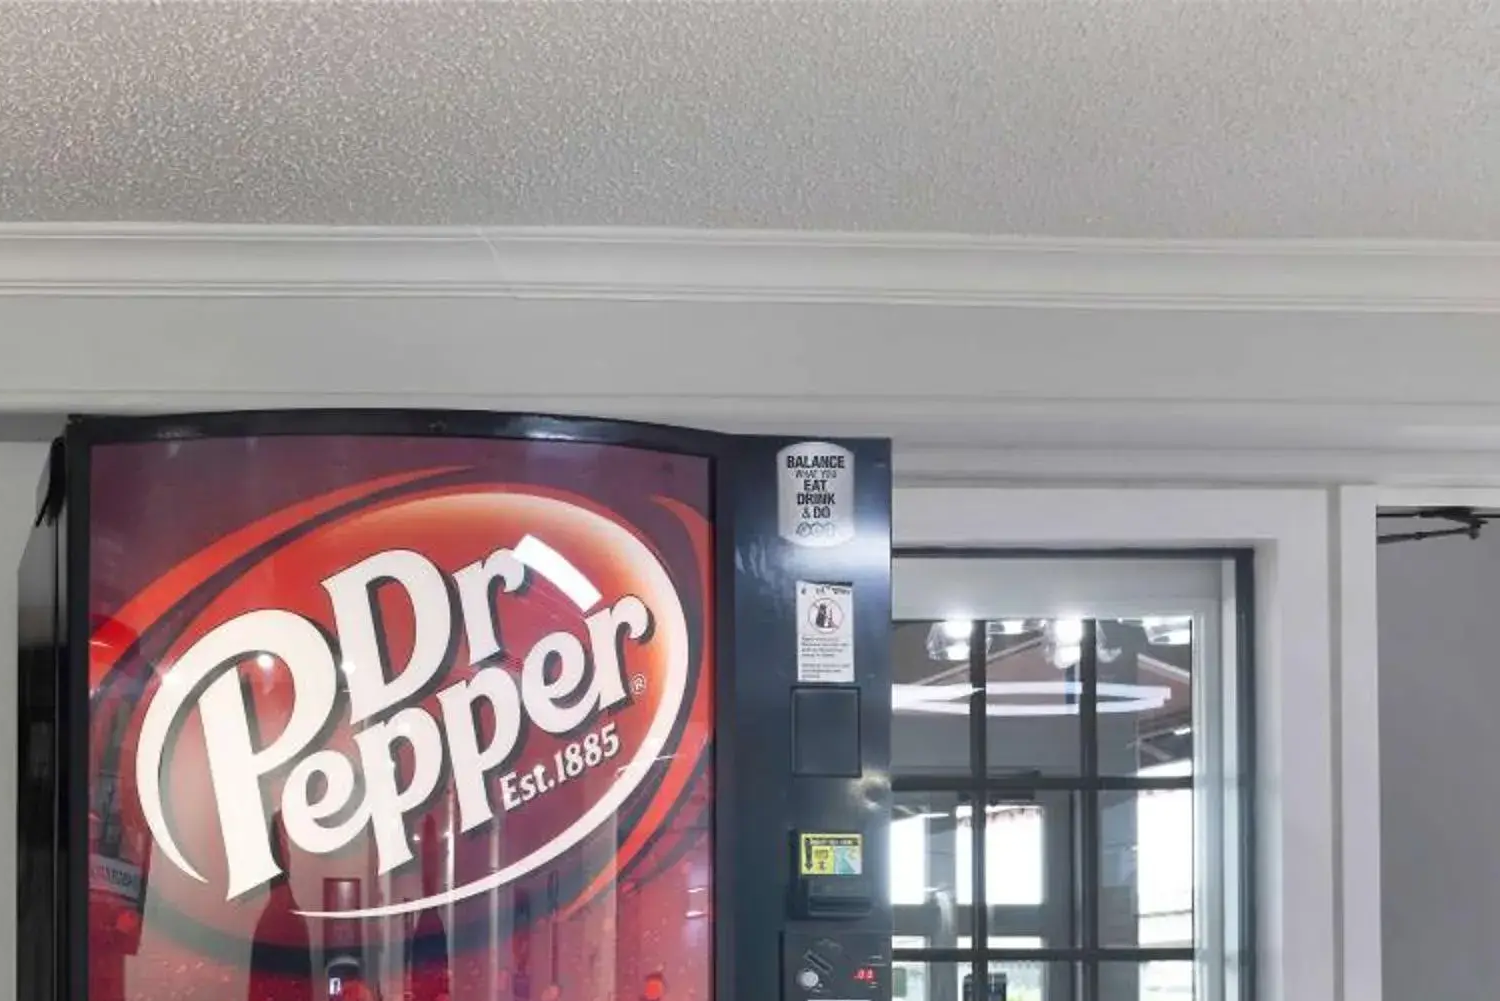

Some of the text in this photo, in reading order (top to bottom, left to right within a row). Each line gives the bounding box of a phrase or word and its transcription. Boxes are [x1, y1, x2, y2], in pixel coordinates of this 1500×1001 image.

[787, 455, 845, 469] BALANCE
[803, 480, 828, 491] EAT
[796, 493, 836, 505] DRINK
[802, 507, 831, 519] & DO
[320, 547, 527, 726] Dr
[135, 593, 656, 902] Pepper
